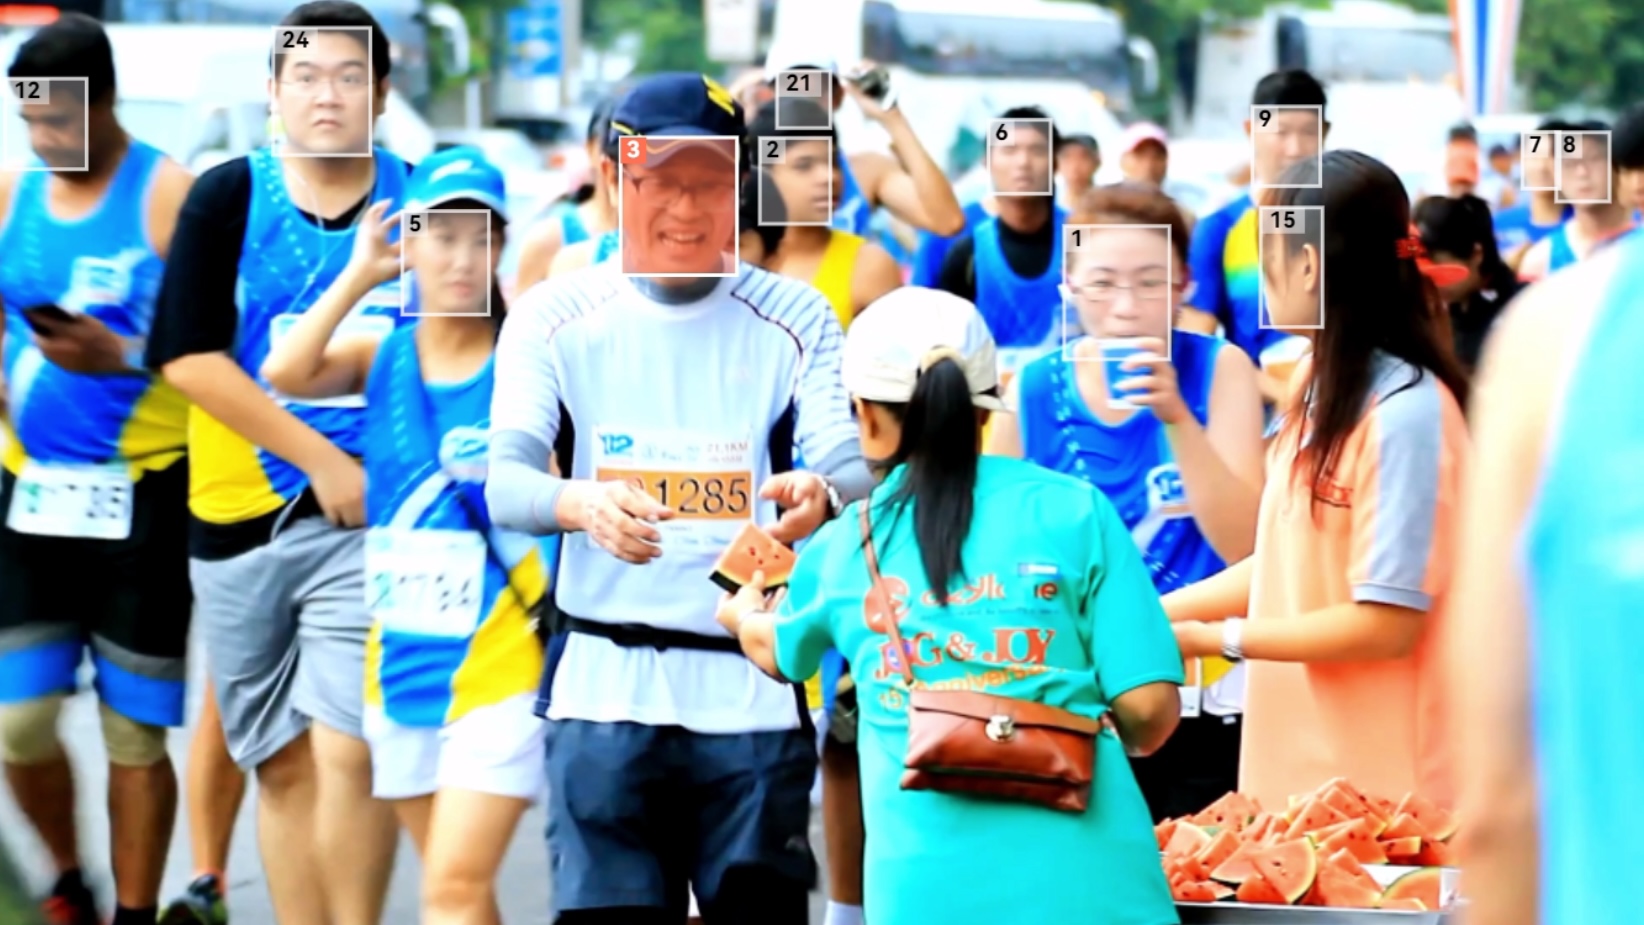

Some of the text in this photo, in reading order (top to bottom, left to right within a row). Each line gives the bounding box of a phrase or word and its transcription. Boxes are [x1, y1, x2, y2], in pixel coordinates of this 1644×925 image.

[626, 477, 747, 514] 1285
[945, 633, 976, 662] &
[982, 629, 1055, 664] JOY
